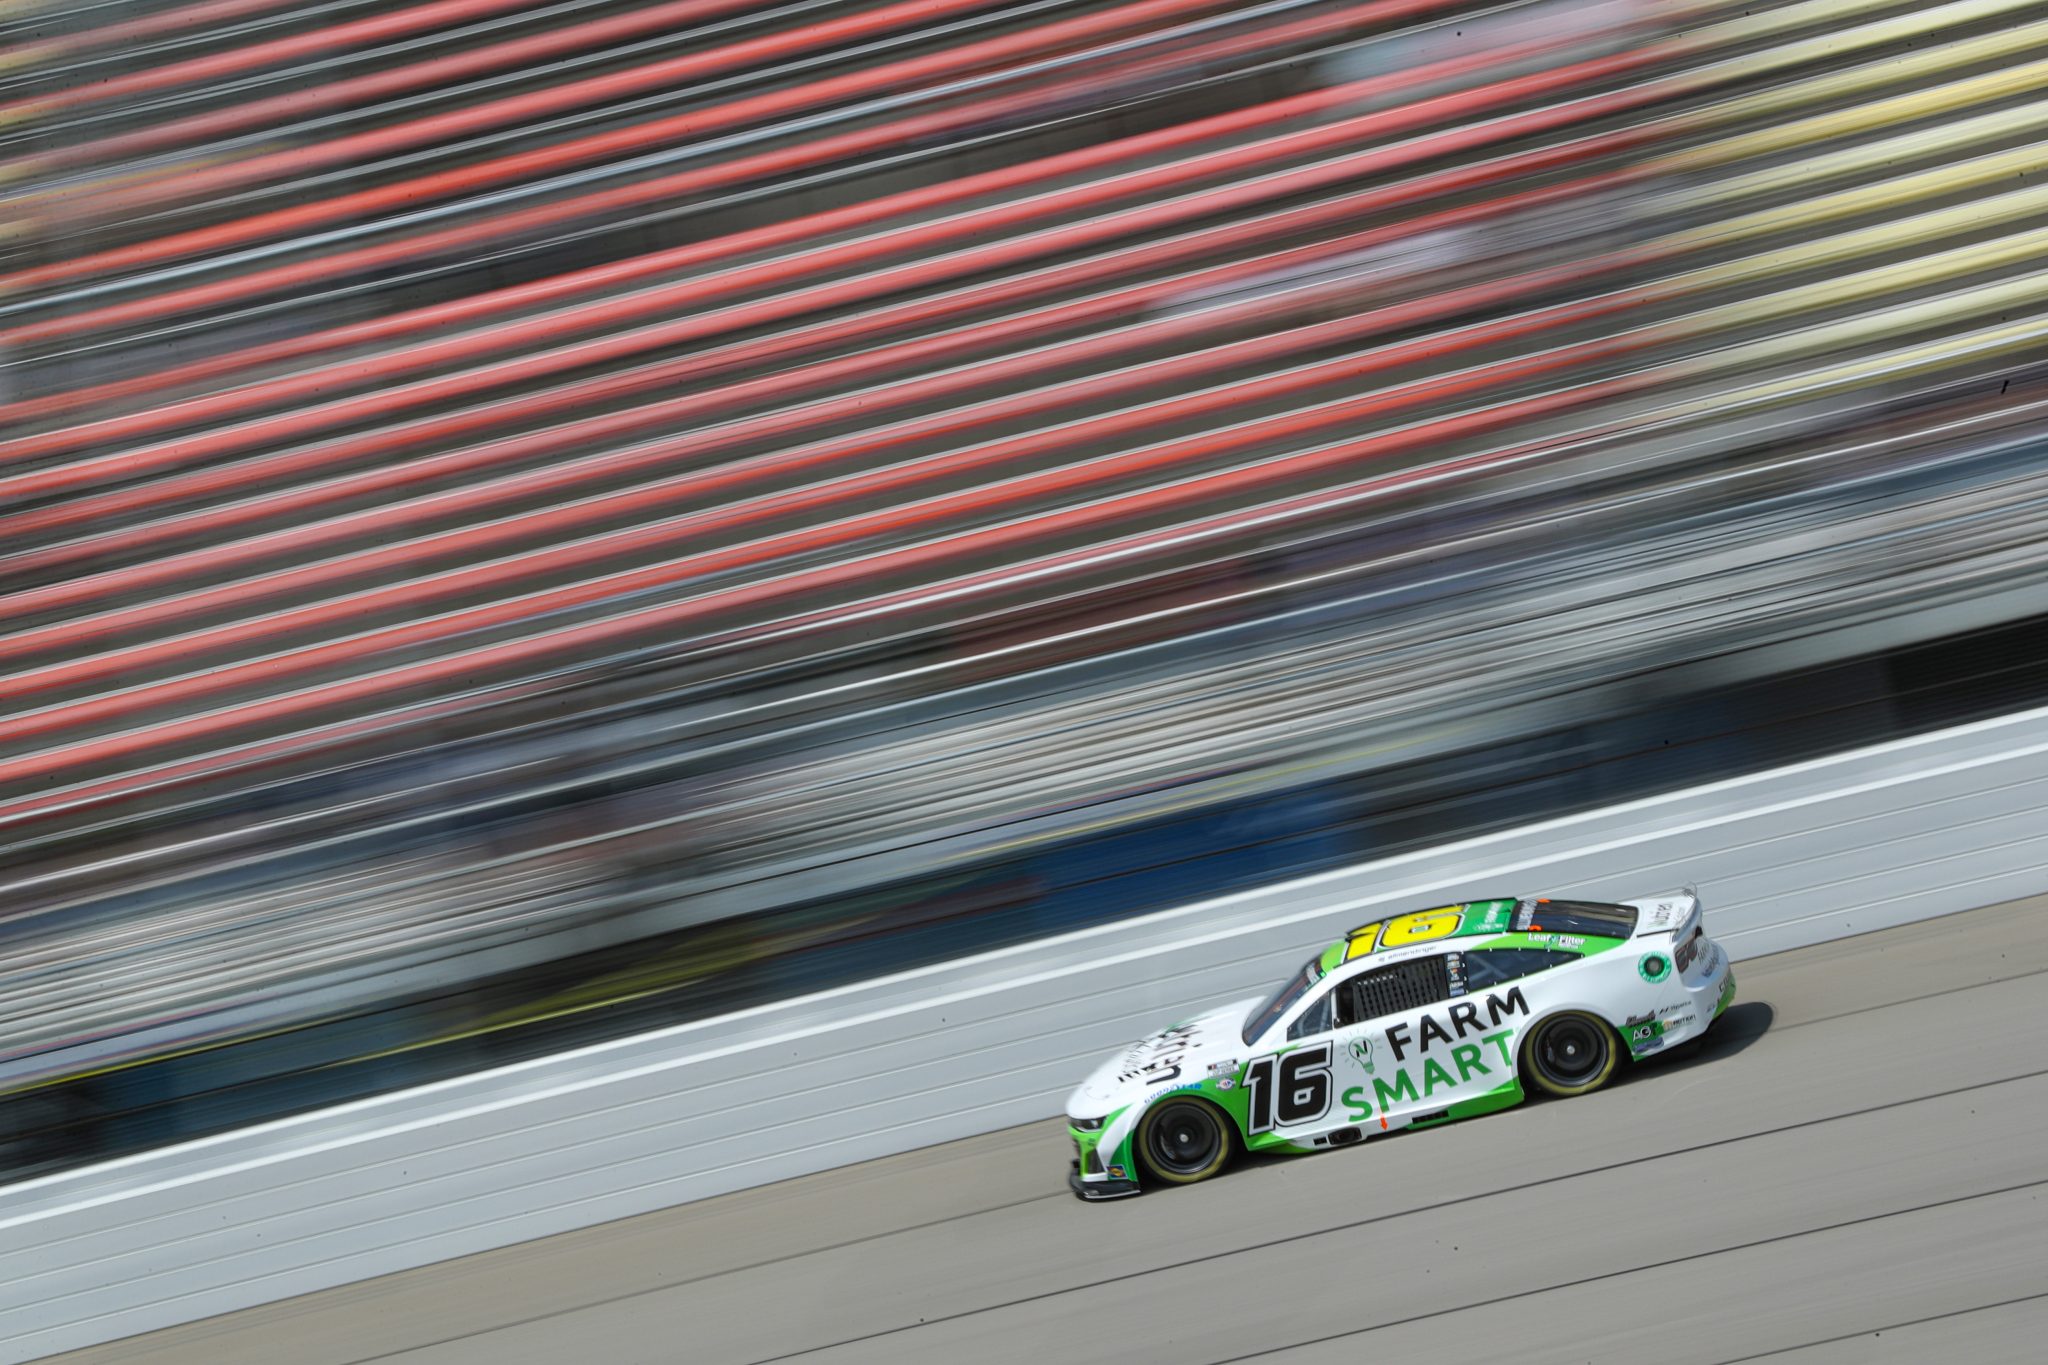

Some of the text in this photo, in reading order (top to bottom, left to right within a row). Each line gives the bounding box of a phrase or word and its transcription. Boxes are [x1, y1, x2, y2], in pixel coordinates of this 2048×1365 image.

[1342, 903, 1470, 963] 16
[1385, 986, 1530, 1062] FARM
[1240, 1040, 1334, 1137] 16
[1341, 1028, 1514, 1122] SMART
